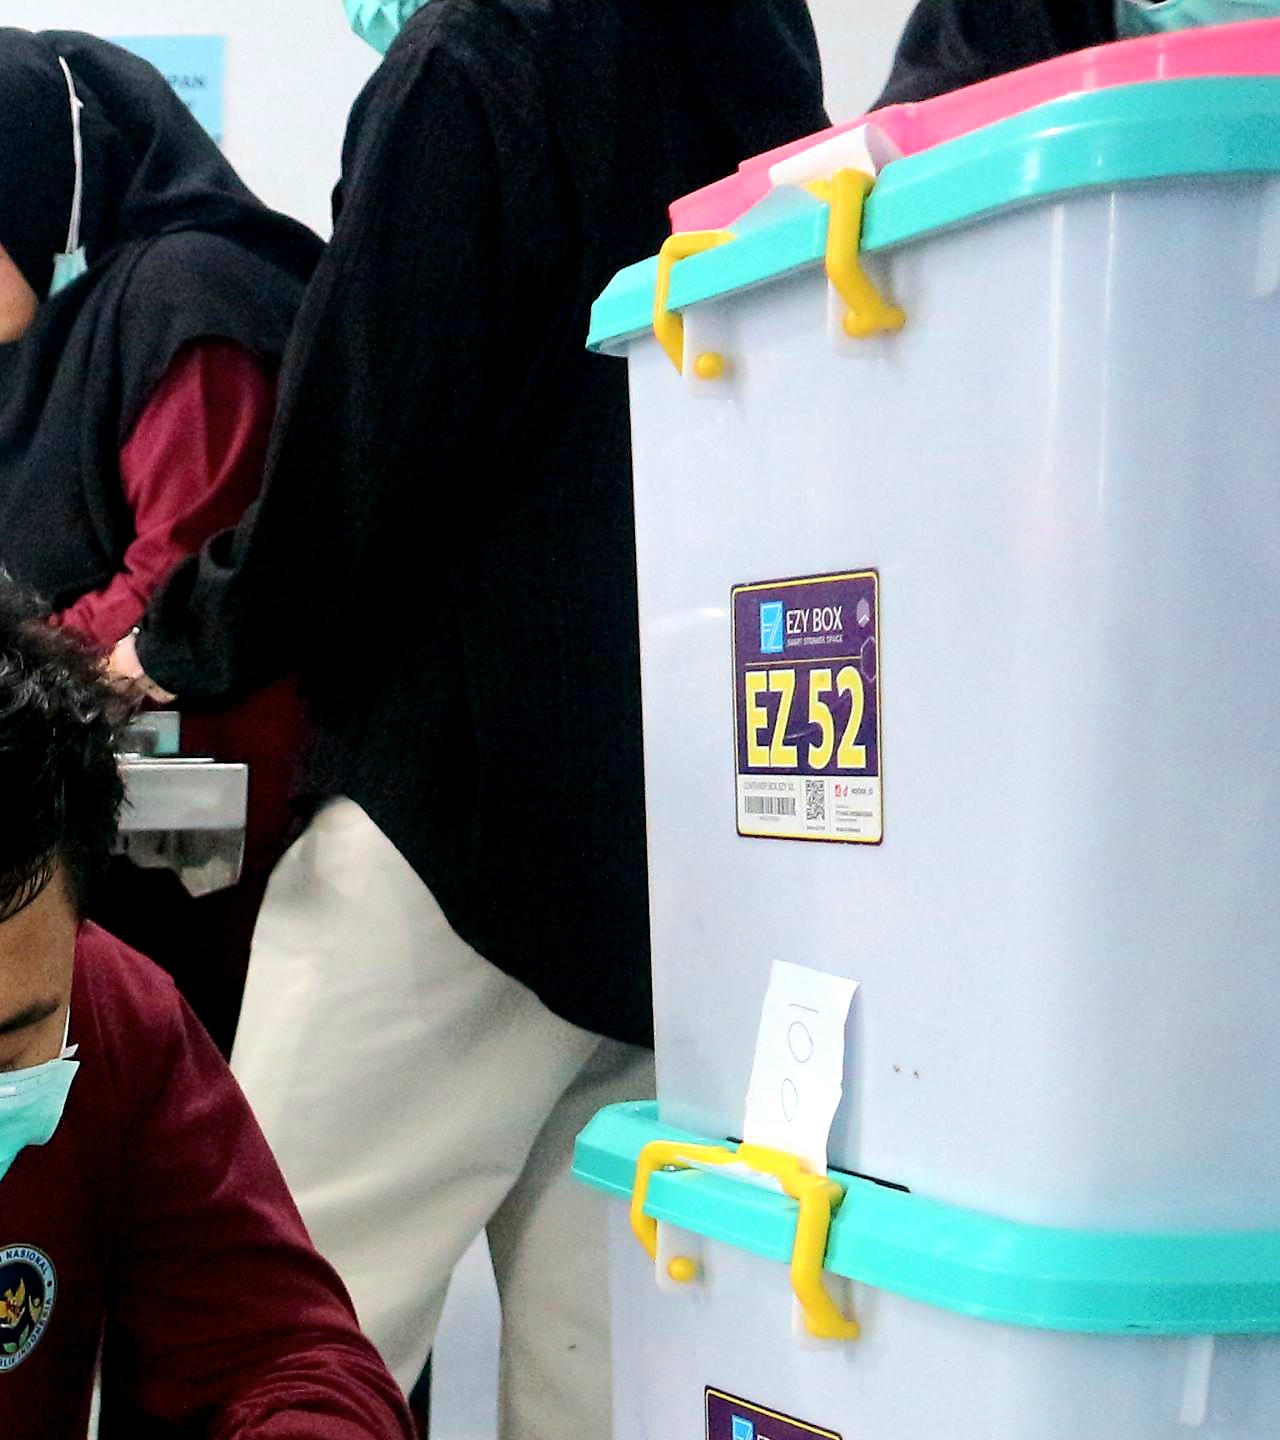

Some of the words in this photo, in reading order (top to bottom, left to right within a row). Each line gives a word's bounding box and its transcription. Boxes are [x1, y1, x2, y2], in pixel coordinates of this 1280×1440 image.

[786, 608, 810, 634] EZY
[812, 605, 843, 632] BOX
[745, 669, 799, 768] EZ
[807, 665, 867, 770] 52
[6, 1249, 49, 1275] NASIONAL
